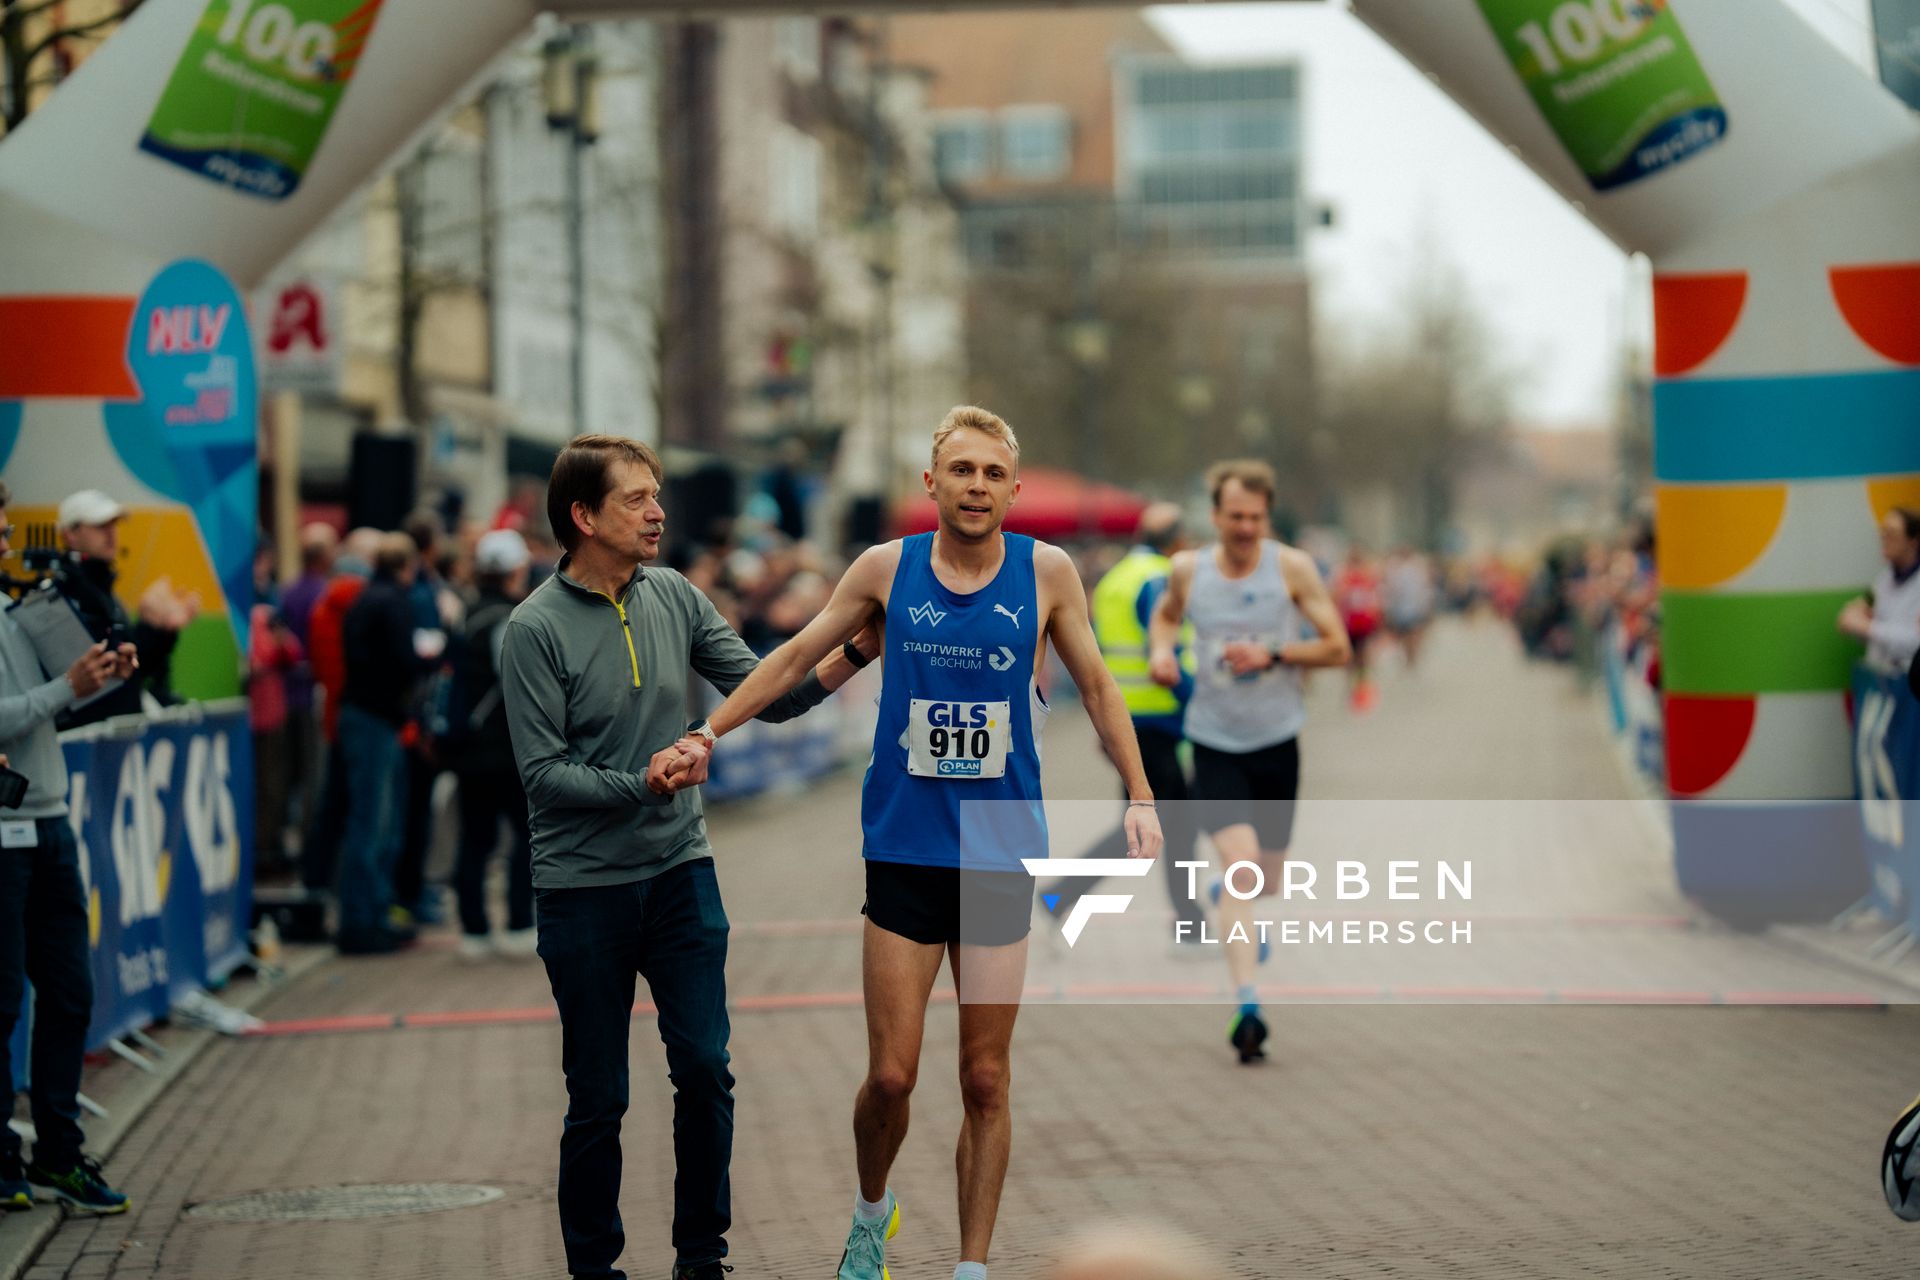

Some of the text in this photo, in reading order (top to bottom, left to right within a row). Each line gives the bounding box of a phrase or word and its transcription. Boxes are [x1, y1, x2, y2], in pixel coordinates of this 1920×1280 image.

[147, 303, 230, 357] NLV
[903, 641, 982, 658] STADTWERKE
[930, 657, 982, 670] BOCHUM
[929, 728, 990, 759] 910
[955, 762, 980, 771] PLAN
